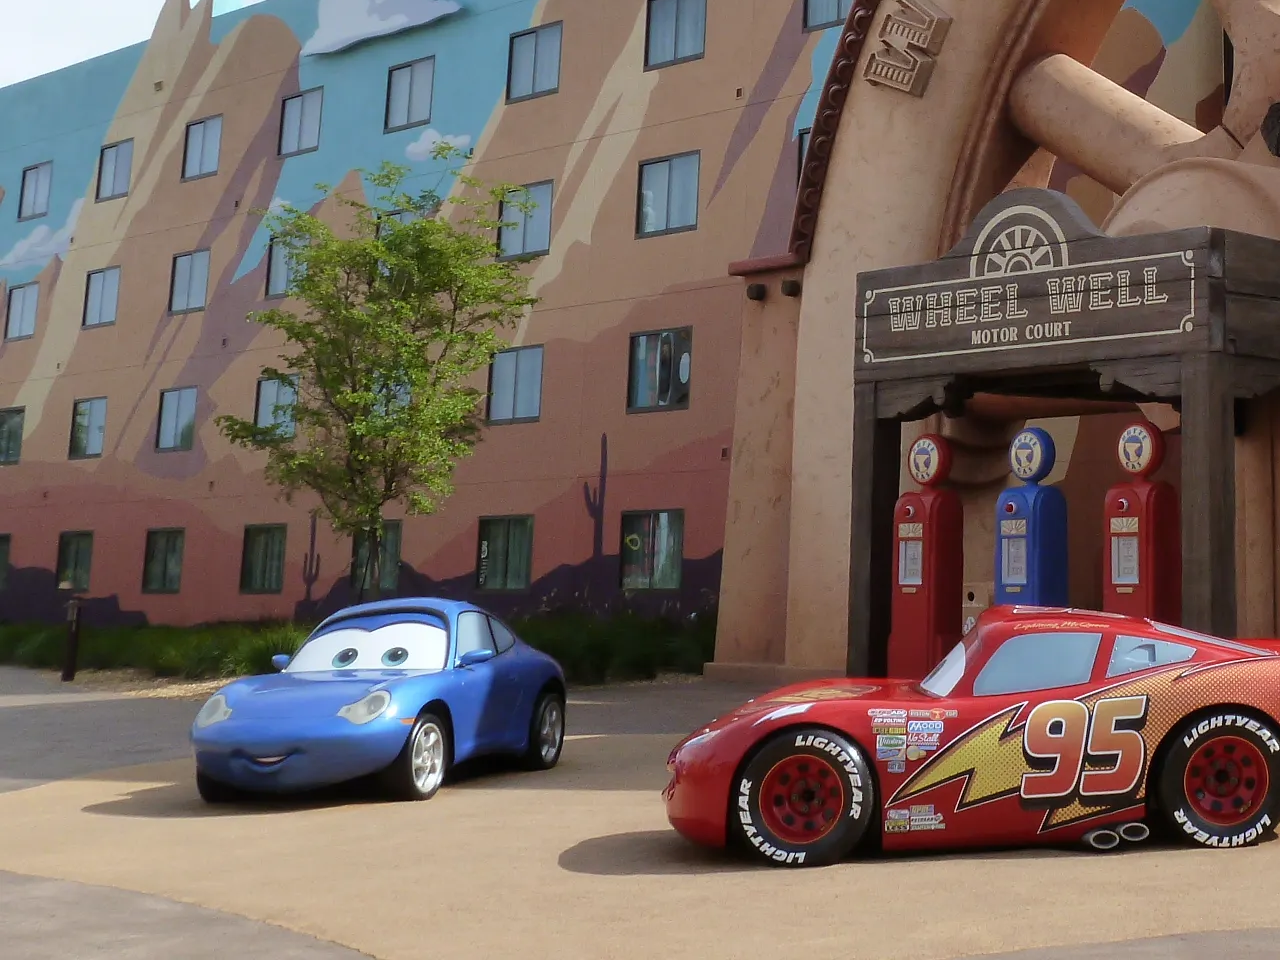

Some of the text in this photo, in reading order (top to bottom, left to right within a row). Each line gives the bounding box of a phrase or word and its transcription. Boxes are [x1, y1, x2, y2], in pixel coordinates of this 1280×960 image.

[888, 266, 1168, 332] WHEEL WELL
[971, 321, 1072, 345] MOTOR COURT
[909, 723, 942, 731] MOOD
[918, 733, 940, 742] Stall
[1020, 695, 1148, 799] 95
[1183, 714, 1280, 754] LIGHTYEAR
[795, 735, 863, 820] LIGHTYEAR
[738, 778, 806, 864] LIGHTYEAR
[1174, 808, 1272, 847] LIGHTYEAR
